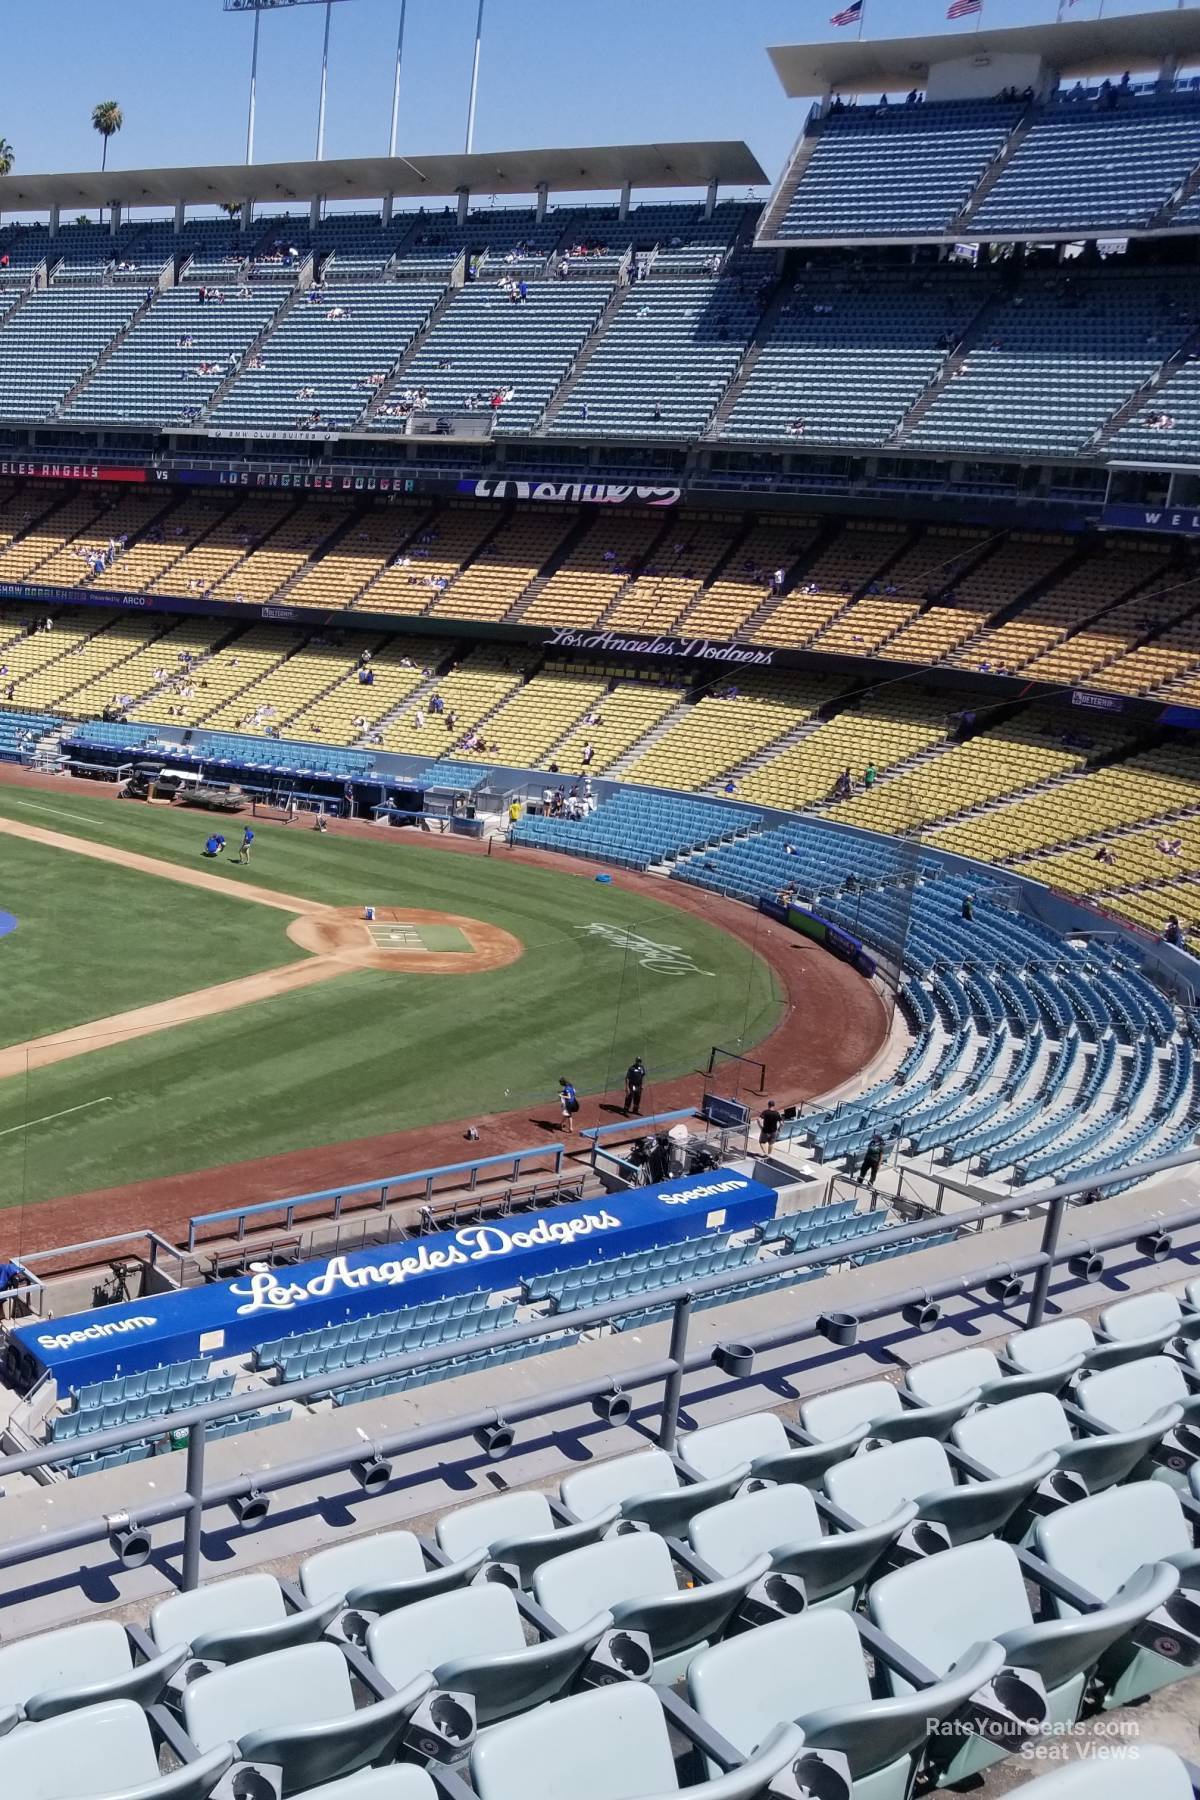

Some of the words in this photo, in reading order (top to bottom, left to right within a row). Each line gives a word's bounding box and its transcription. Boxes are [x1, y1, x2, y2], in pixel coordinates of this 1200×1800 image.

[42, 465, 99, 478] ANGELS
[156, 471, 168, 480] VS
[219, 472, 248, 485] LOS
[256, 474, 333, 489] ANGELES
[123, 595, 145, 606] ARCO
[543, 627, 581, 647] Los
[582, 630, 673, 655] Angeles
[674, 635, 777, 664] Dodgers
[657, 1180, 748, 1205] Spectrum
[229, 1271, 309, 1315] Los
[306, 1244, 469, 1295] Angeles
[455, 1210, 622, 1260] Dodgers
[37, 1316, 157, 1349] Spectrum
